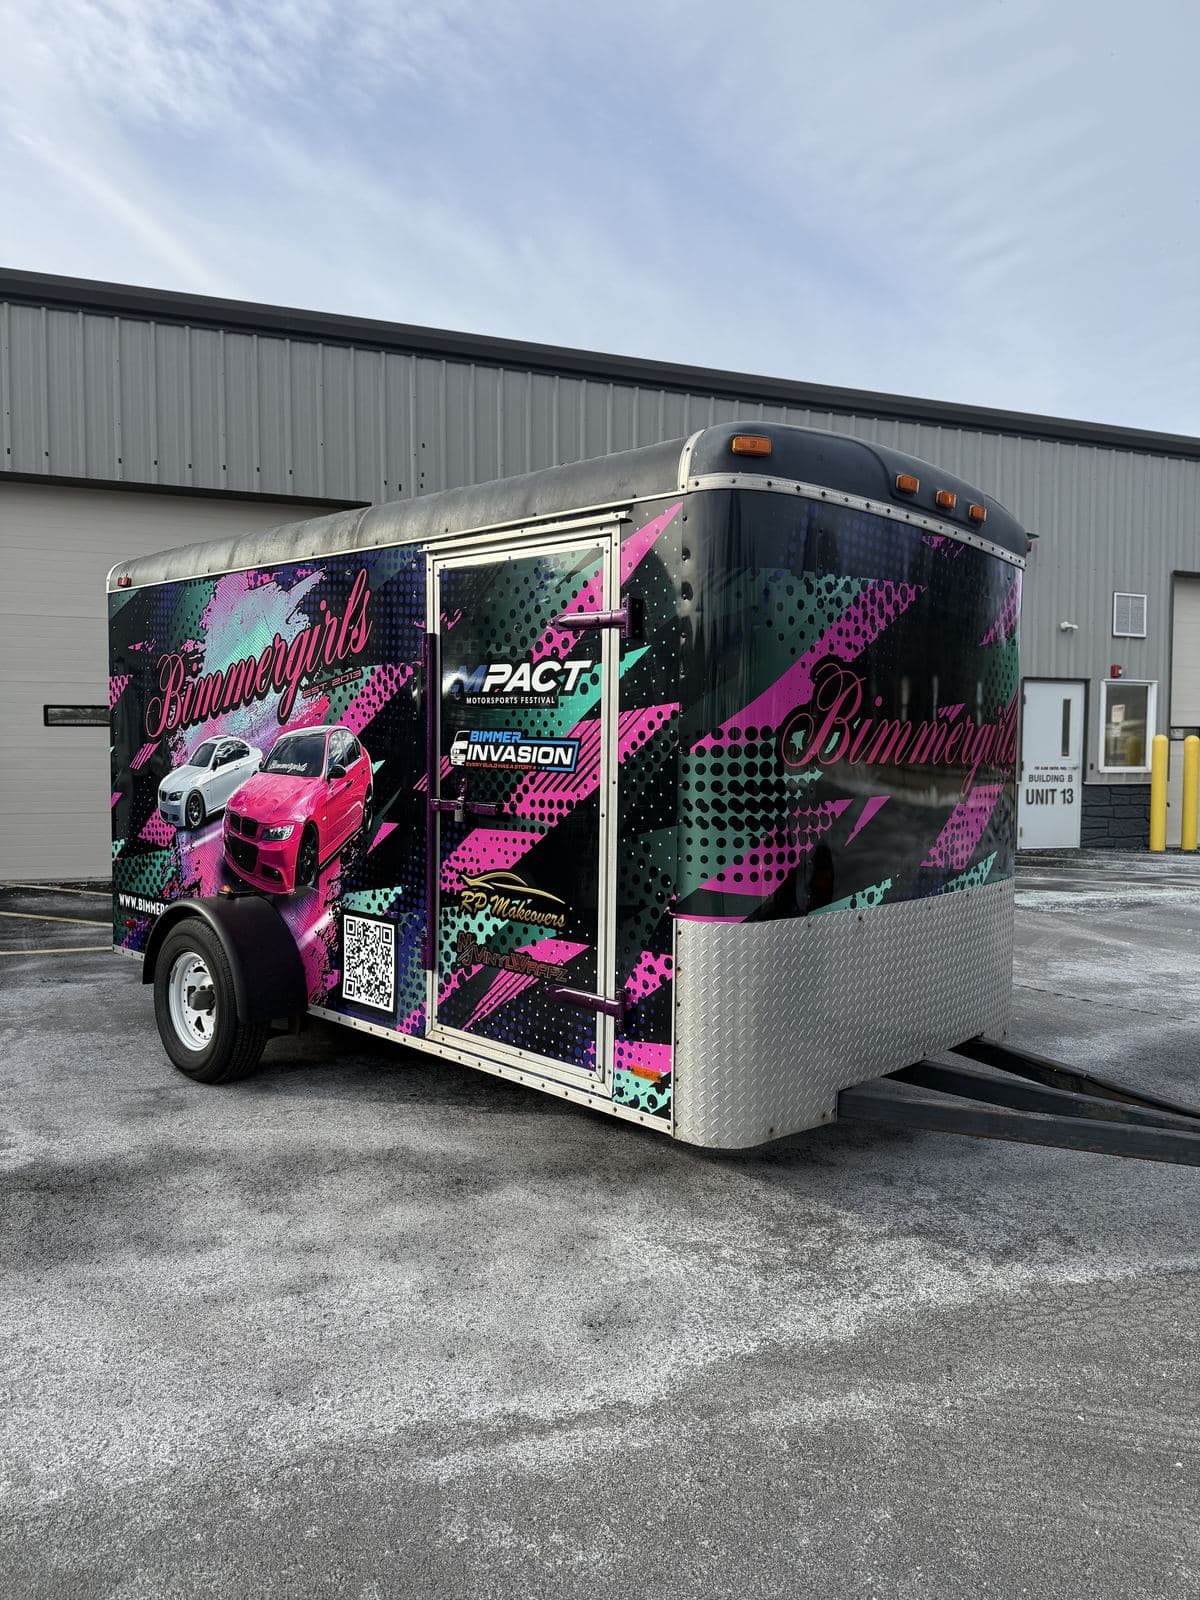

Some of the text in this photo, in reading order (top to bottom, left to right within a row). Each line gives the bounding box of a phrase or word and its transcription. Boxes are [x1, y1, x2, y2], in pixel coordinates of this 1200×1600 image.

[145, 567, 374, 739] Bimmergirls
[303, 669, 362, 698] EST. 2013
[466, 696, 555, 705] MOTORSPORTS FESTIVAL
[470, 730, 521, 743] BIMMER
[466, 744, 573, 765] INVASION
[1028, 774, 1073, 783] BUILDING B
[1025, 788, 1074, 805] UNIT 13
[460, 891, 566, 928] RP Makeovers
